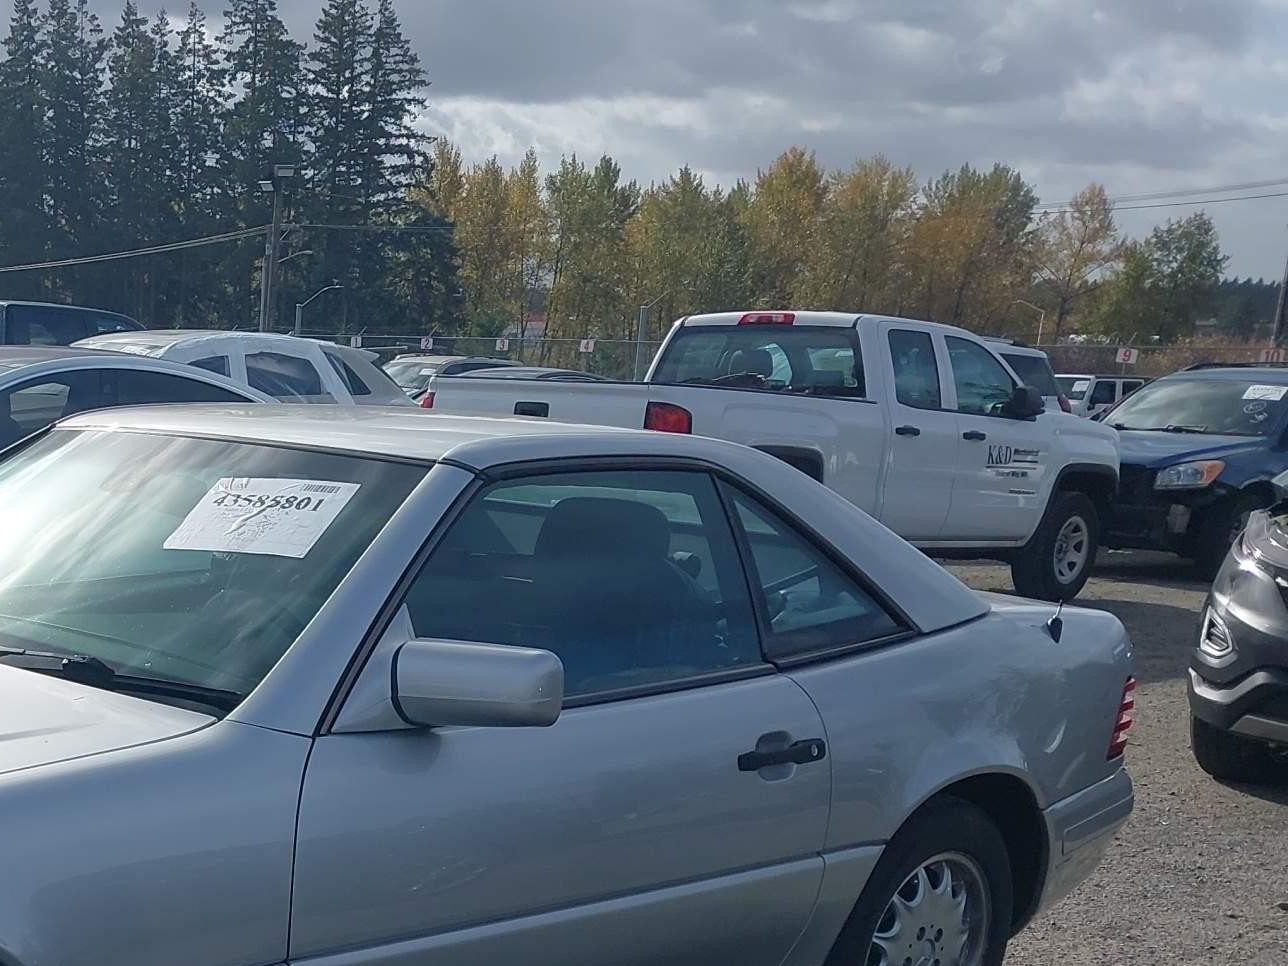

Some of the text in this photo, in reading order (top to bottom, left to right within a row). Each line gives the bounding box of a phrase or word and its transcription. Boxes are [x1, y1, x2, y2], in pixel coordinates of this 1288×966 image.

[1122, 350, 1132, 362] 9
[1264, 350, 1281, 362] 10
[987, 445, 1012, 465] K&D
[212, 492, 325, 512] 43585801
